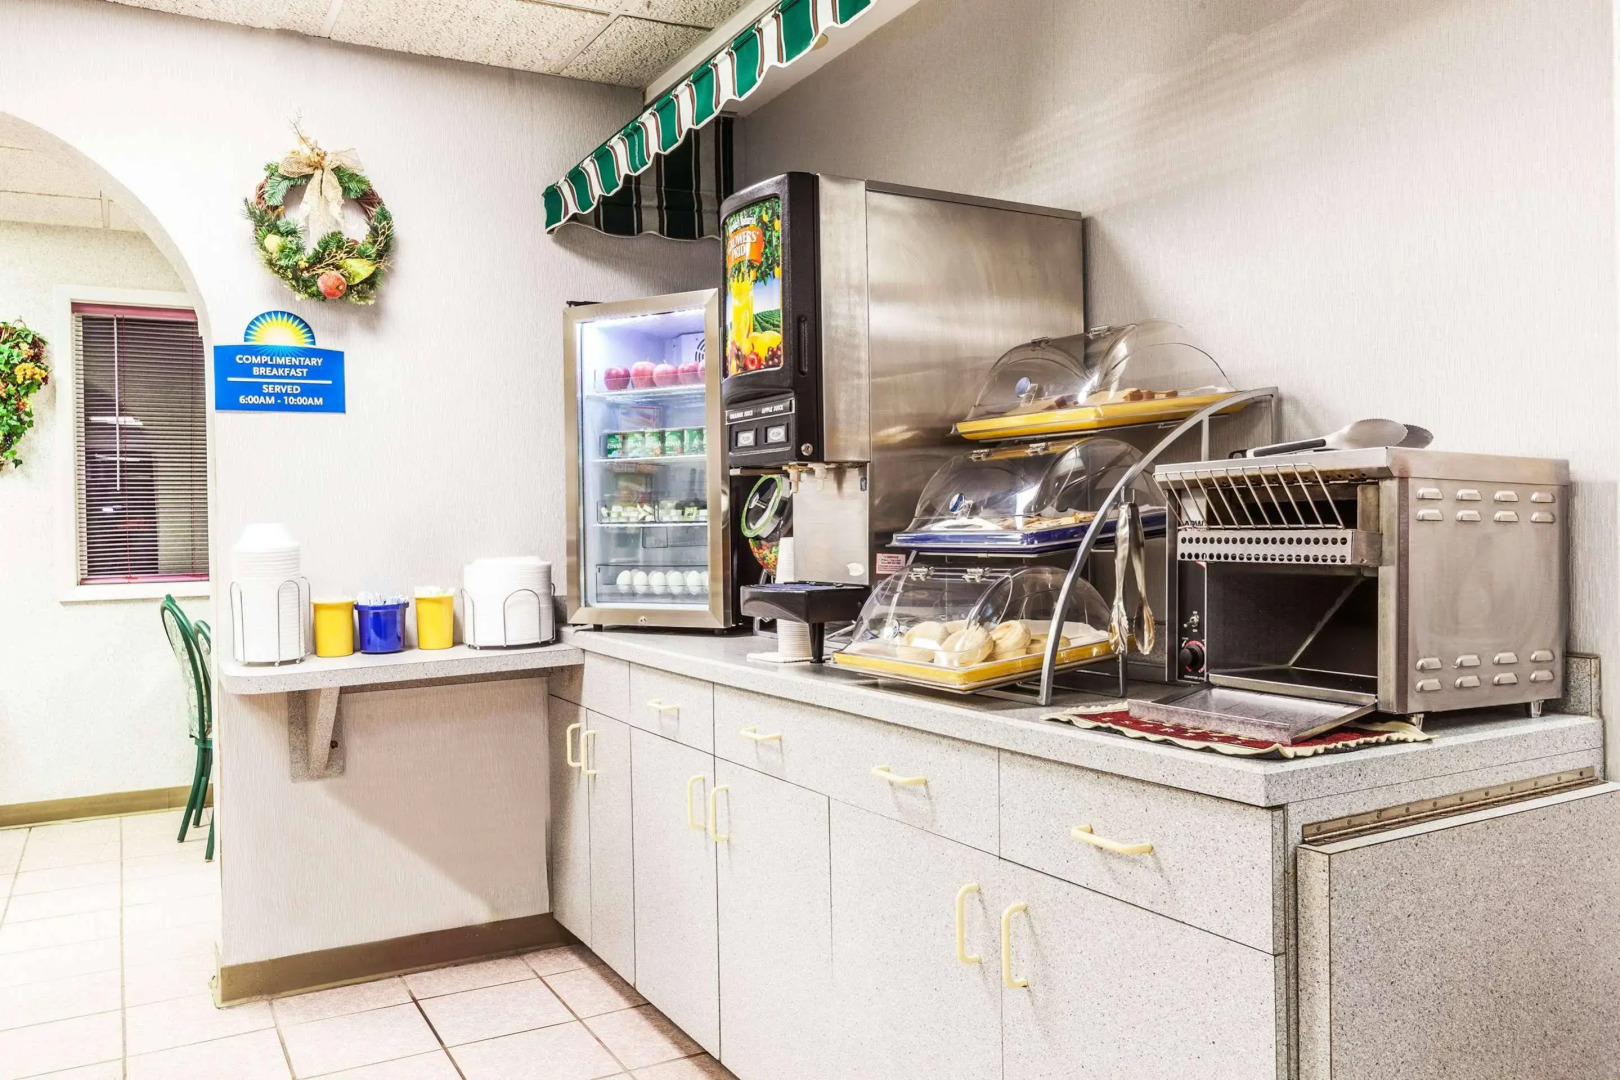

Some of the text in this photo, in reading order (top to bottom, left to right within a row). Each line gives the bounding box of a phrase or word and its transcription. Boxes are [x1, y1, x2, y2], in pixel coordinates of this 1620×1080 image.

[235, 354, 323, 367] COMPLIMENTARY
[252, 366, 309, 377] BREAKFAST
[262, 384, 301, 394] SERVED
[239, 395, 275, 405] 6:00AM
[283, 395, 323, 406] 10:00AM
